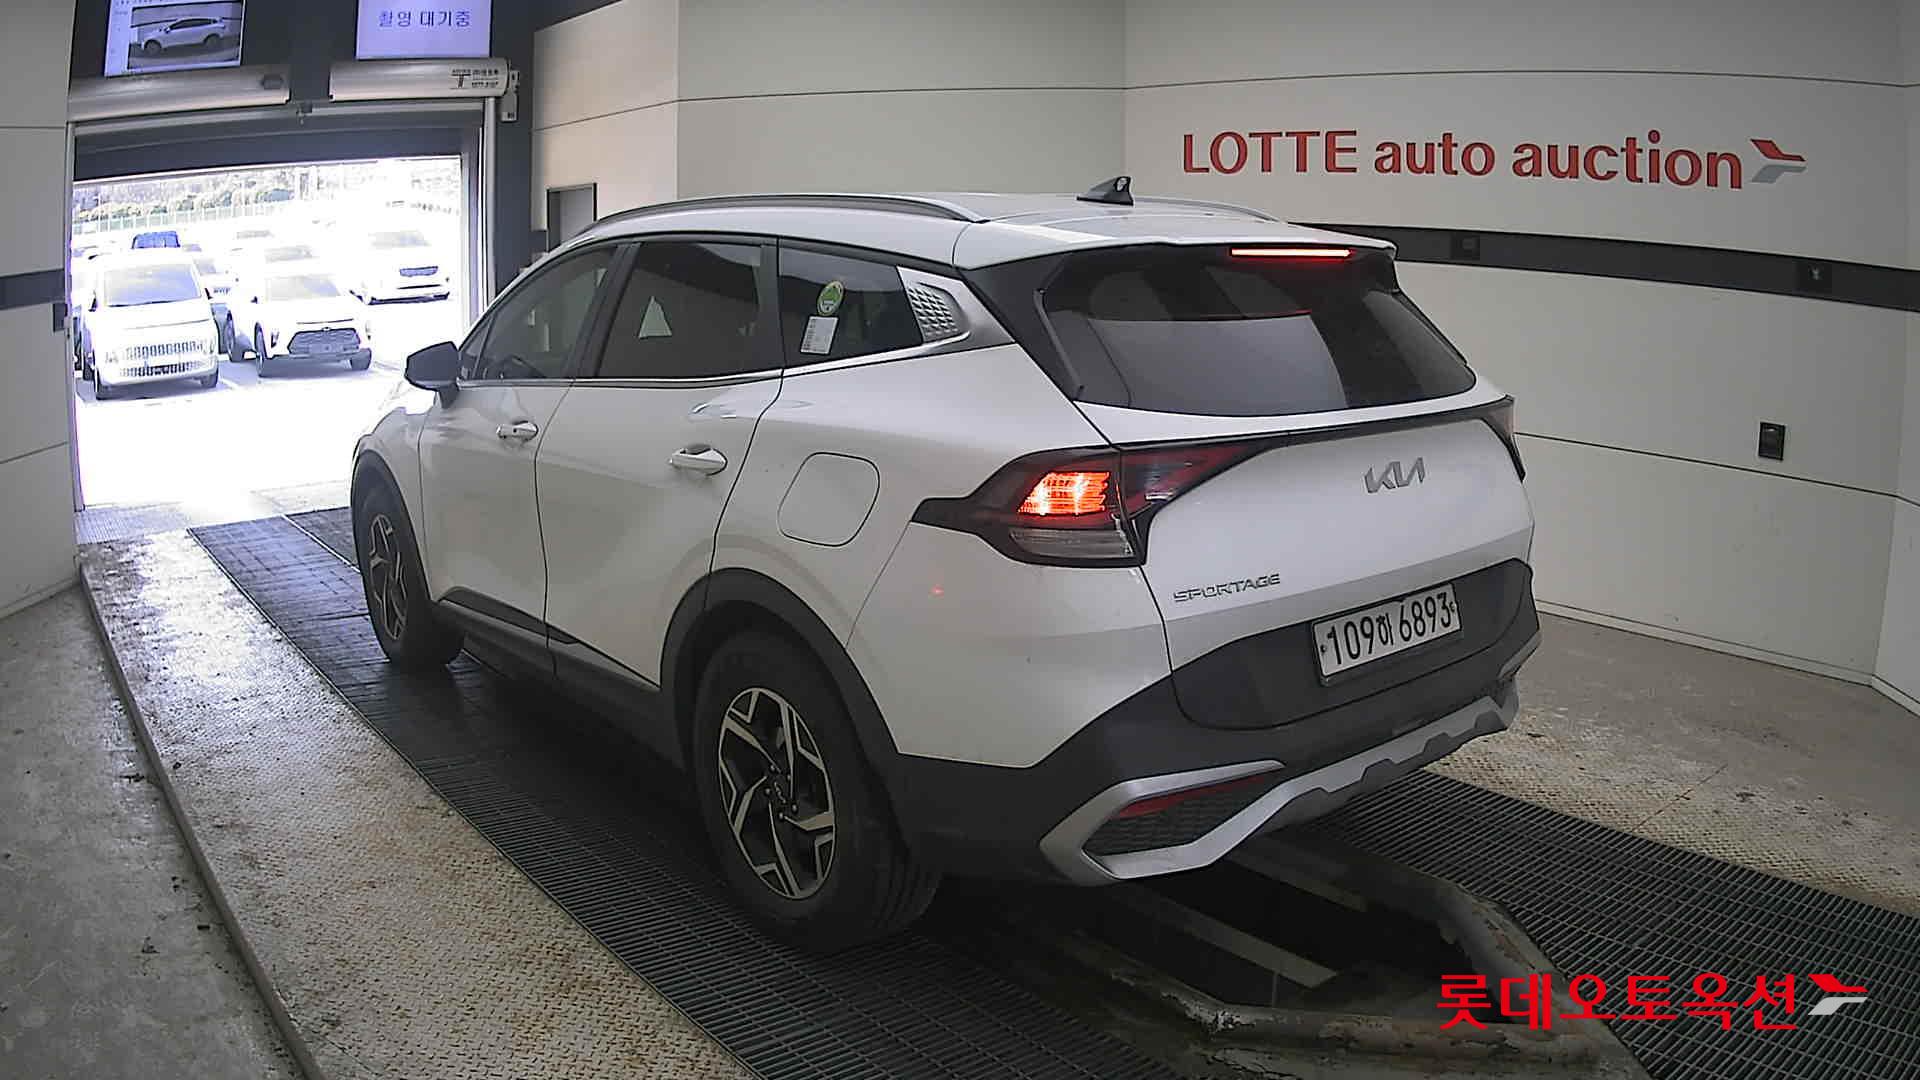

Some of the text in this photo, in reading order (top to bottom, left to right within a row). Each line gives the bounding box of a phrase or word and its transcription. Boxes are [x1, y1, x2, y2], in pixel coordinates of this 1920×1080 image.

[420, 10, 470, 28] 대기중
[1183, 129, 1743, 189] LOTTE auto auction
[1173, 573, 1281, 603] SPORTAGE
